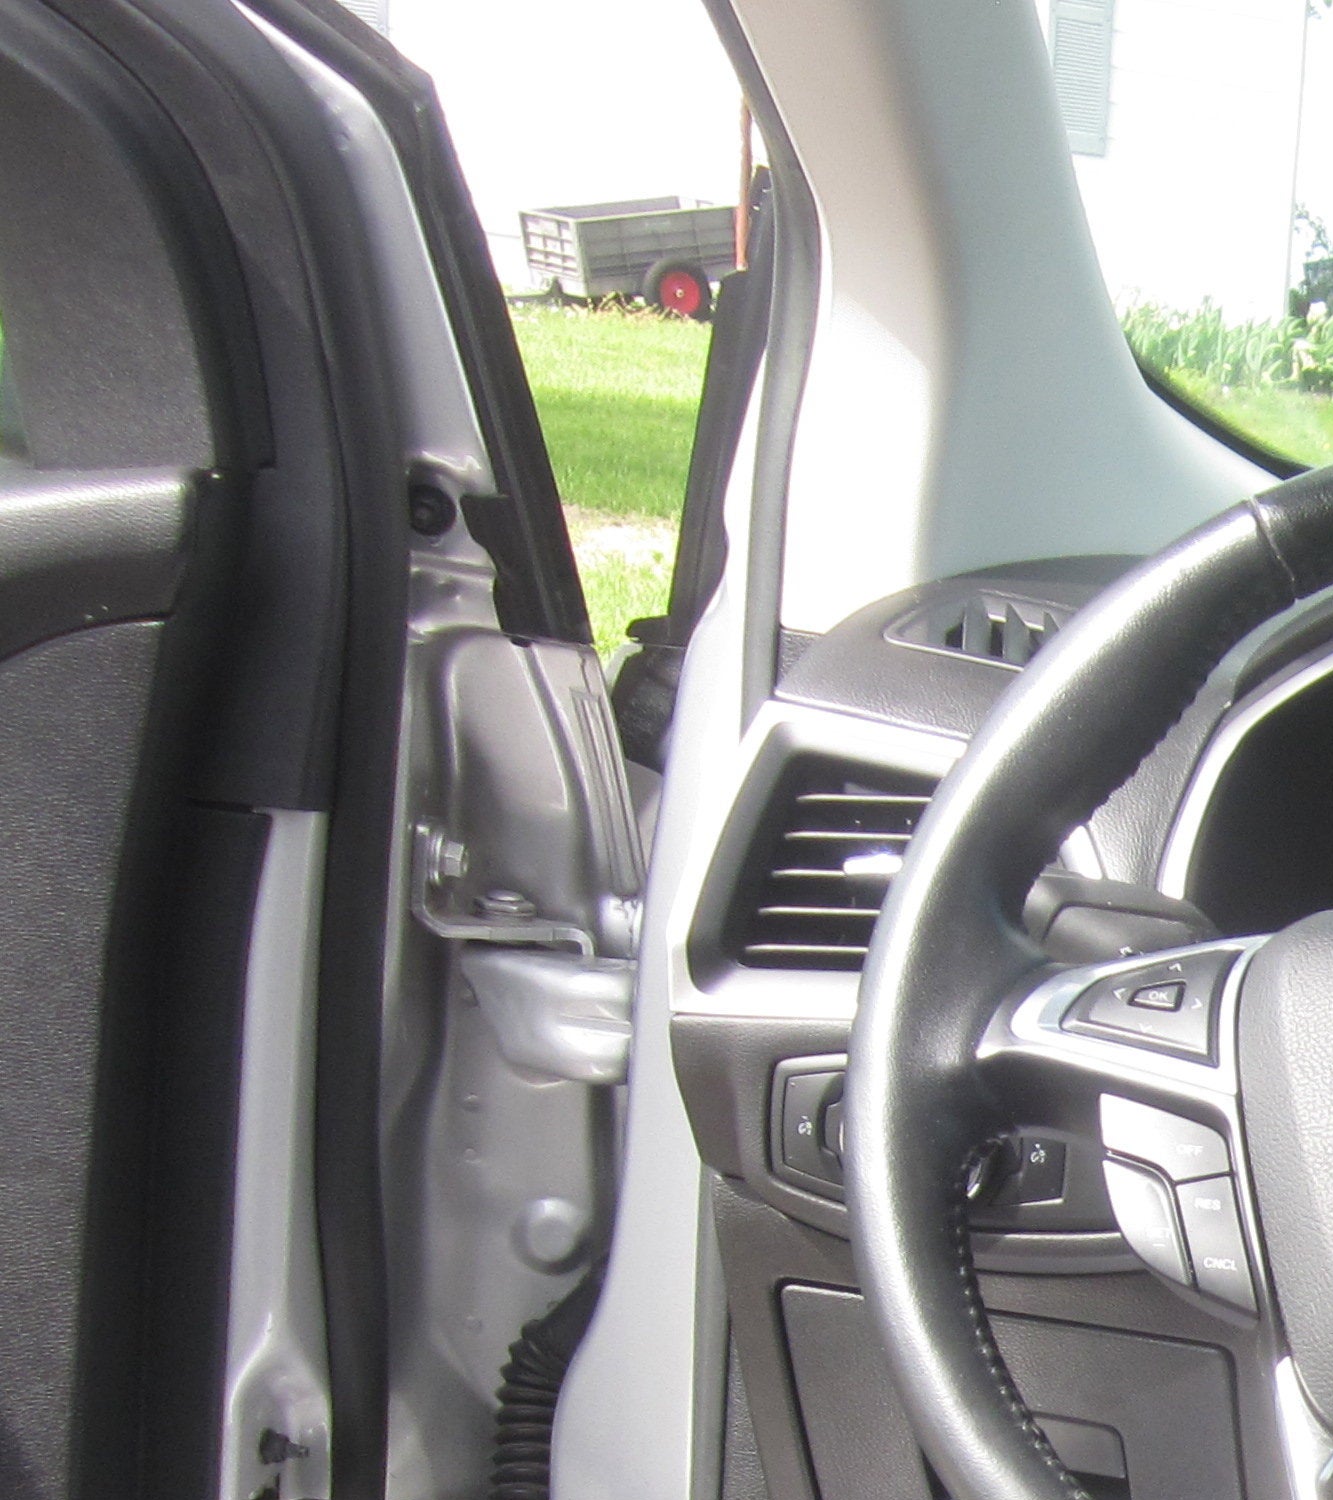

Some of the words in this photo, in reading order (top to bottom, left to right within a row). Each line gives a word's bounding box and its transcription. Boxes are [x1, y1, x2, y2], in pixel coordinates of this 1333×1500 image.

[1148, 990, 1169, 1002] OK
[1195, 1198, 1222, 1211] RES
[1203, 1256, 1238, 1272] CNCL
